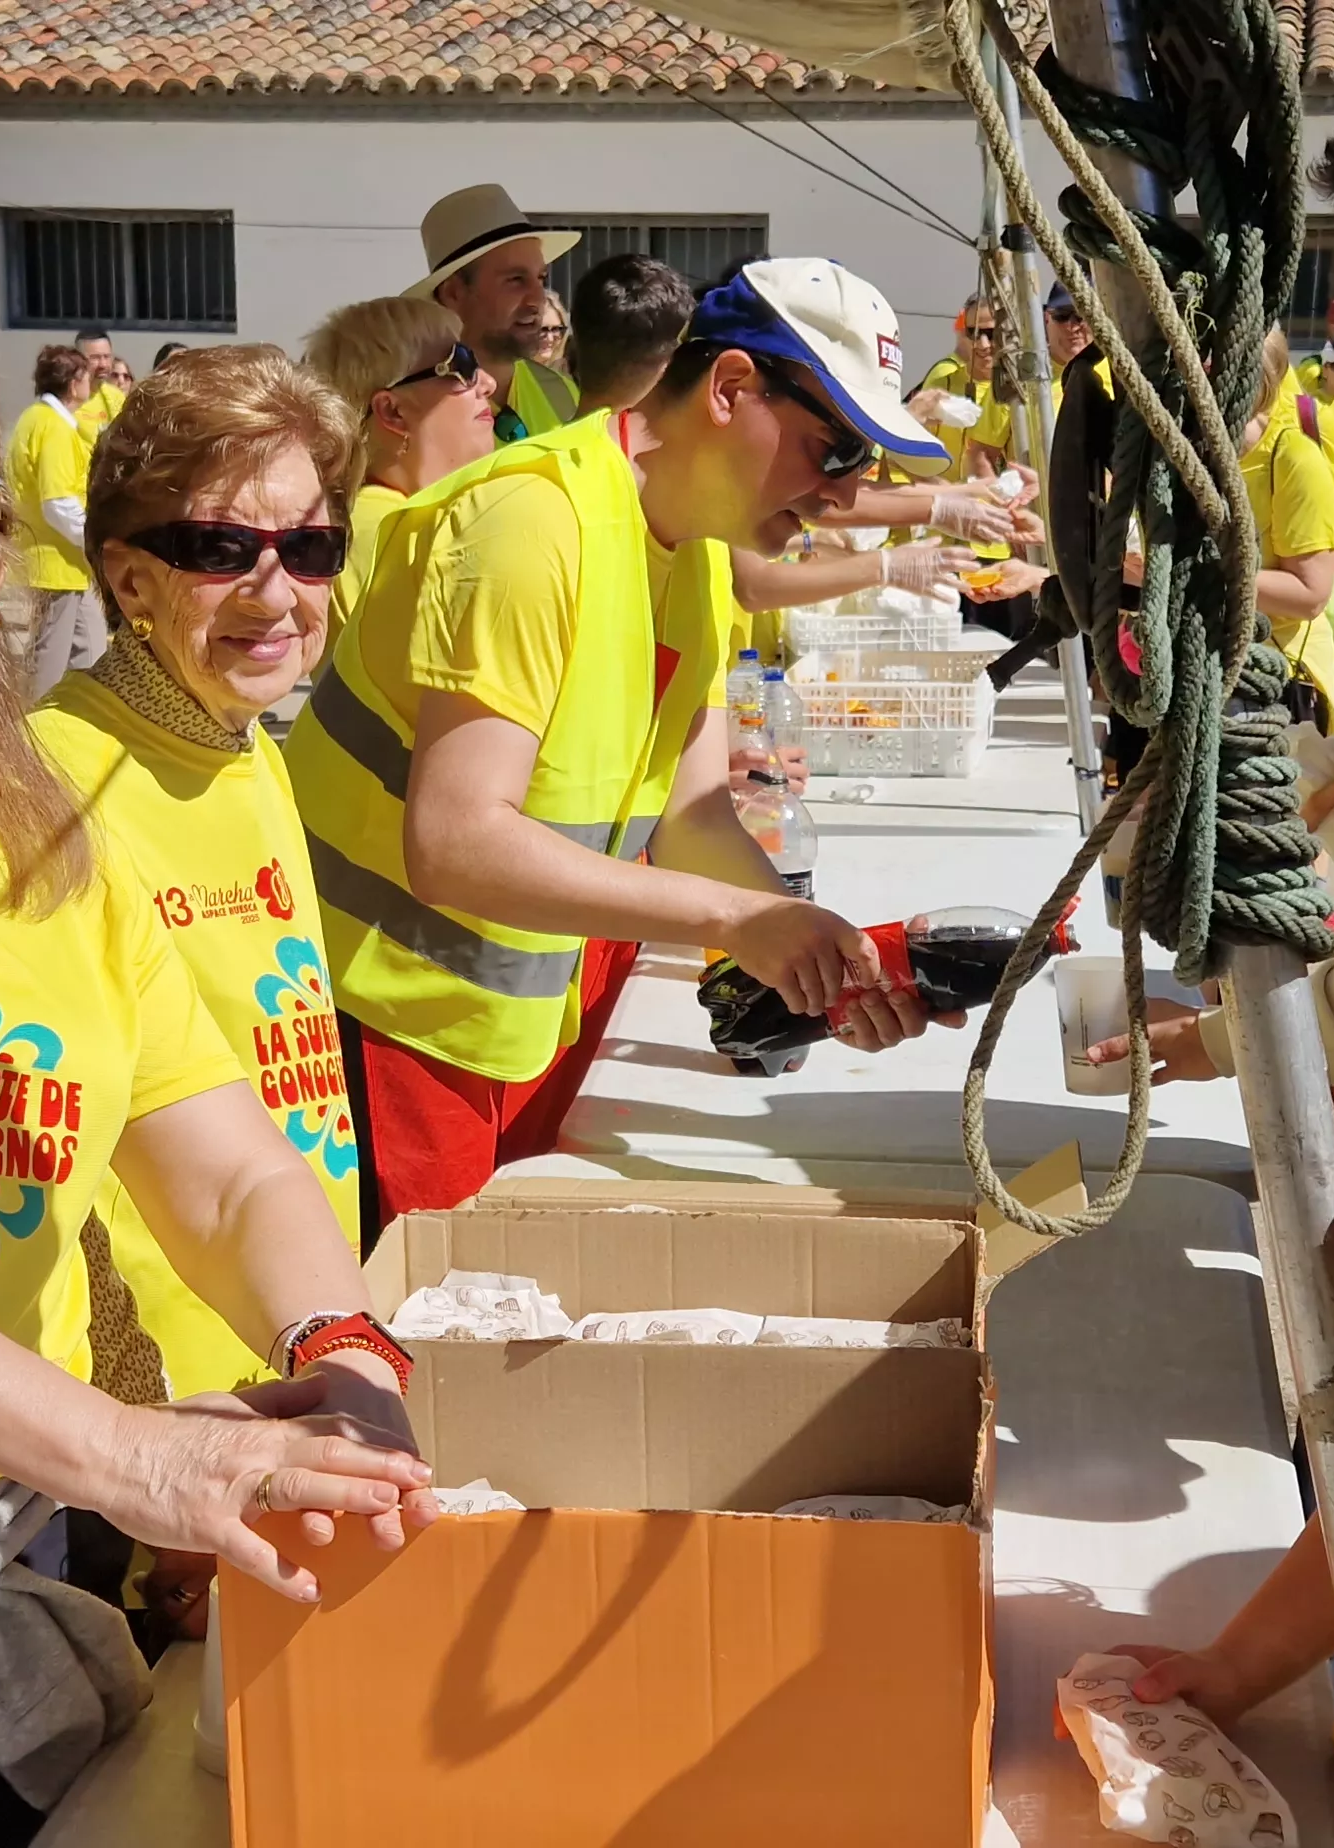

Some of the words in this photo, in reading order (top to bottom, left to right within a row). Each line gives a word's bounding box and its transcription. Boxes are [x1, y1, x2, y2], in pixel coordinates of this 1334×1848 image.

[191, 880, 254, 908] Marcha
[253, 1022, 291, 1067] LA
[40, 1078, 83, 1132] DE
